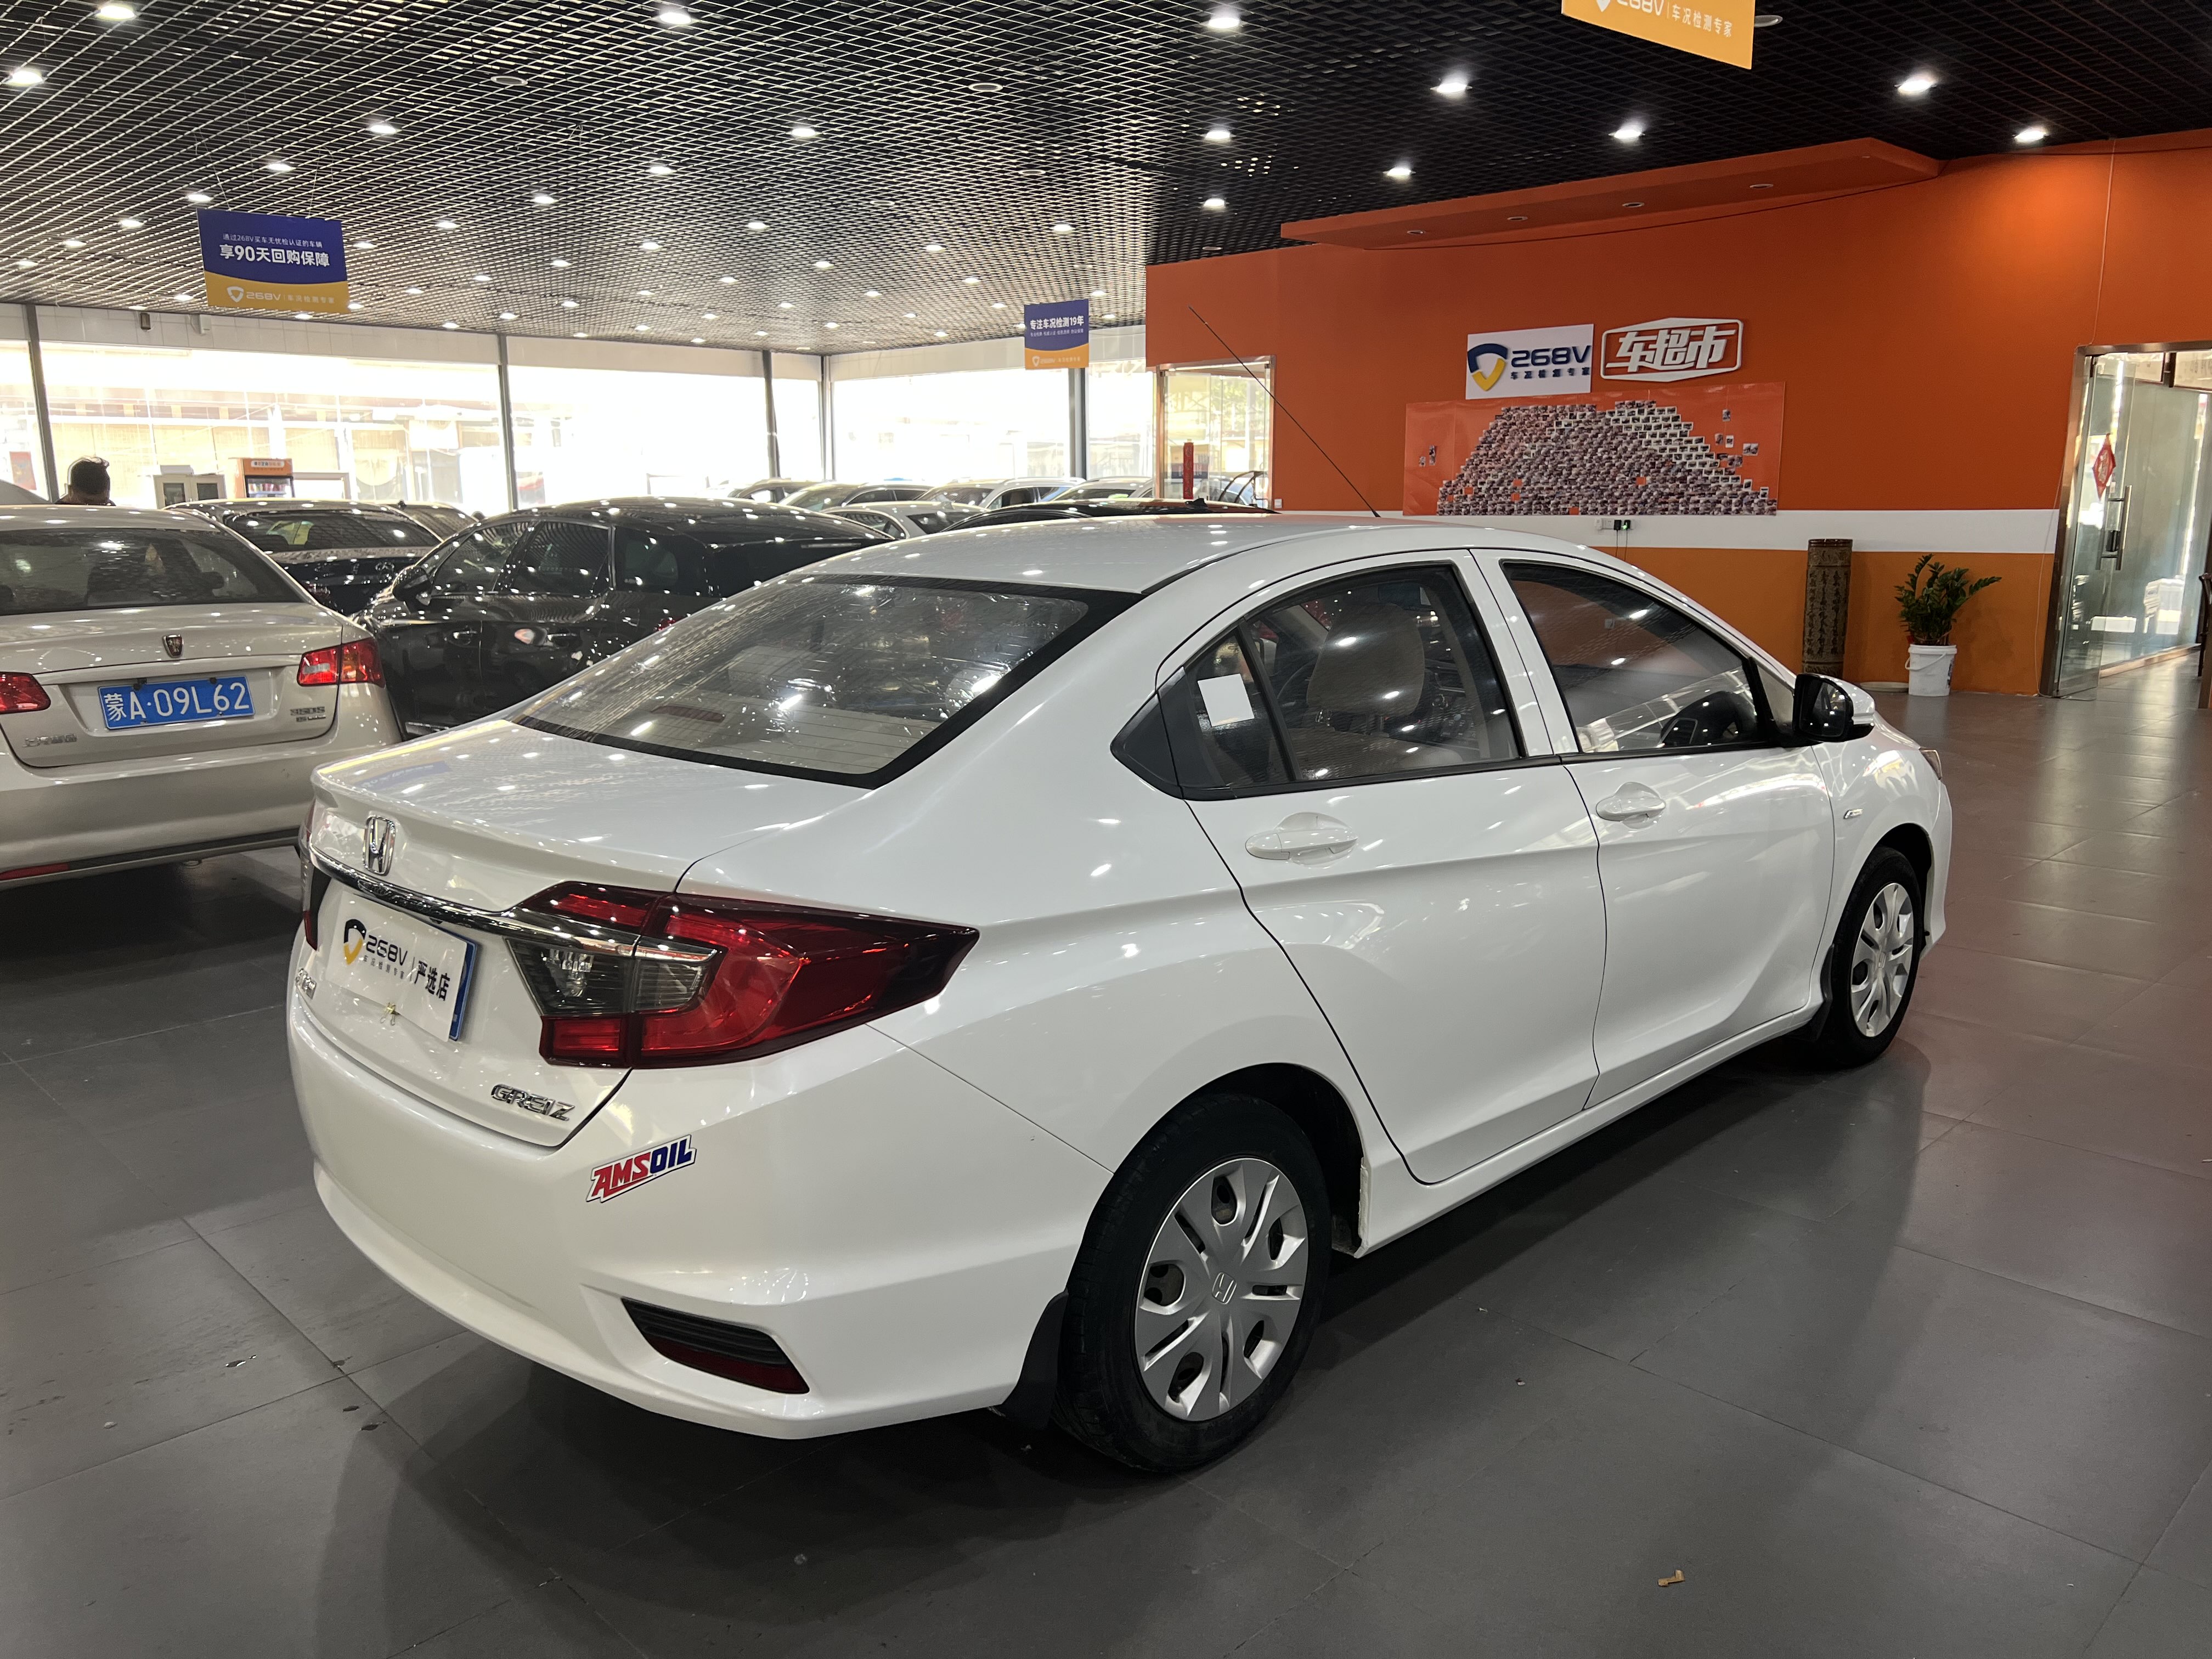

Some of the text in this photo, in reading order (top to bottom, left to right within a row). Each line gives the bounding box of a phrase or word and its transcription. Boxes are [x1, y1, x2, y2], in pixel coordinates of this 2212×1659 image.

[1672, 4, 1732, 38] 车况检测专家
[220, 244, 330, 267] 享90天回购保障
[246, 291, 282, 301] 268V
[1030, 315, 1085, 330] 专注车况检测19年
[1511, 345, 1592, 368] 268V
[1605, 325, 1736, 373] 车超市
[365, 934, 450, 1001] 268V 严选店
[491, 1084, 575, 1121] GREIZ
[591, 1138, 693, 1198] AMSOIL
